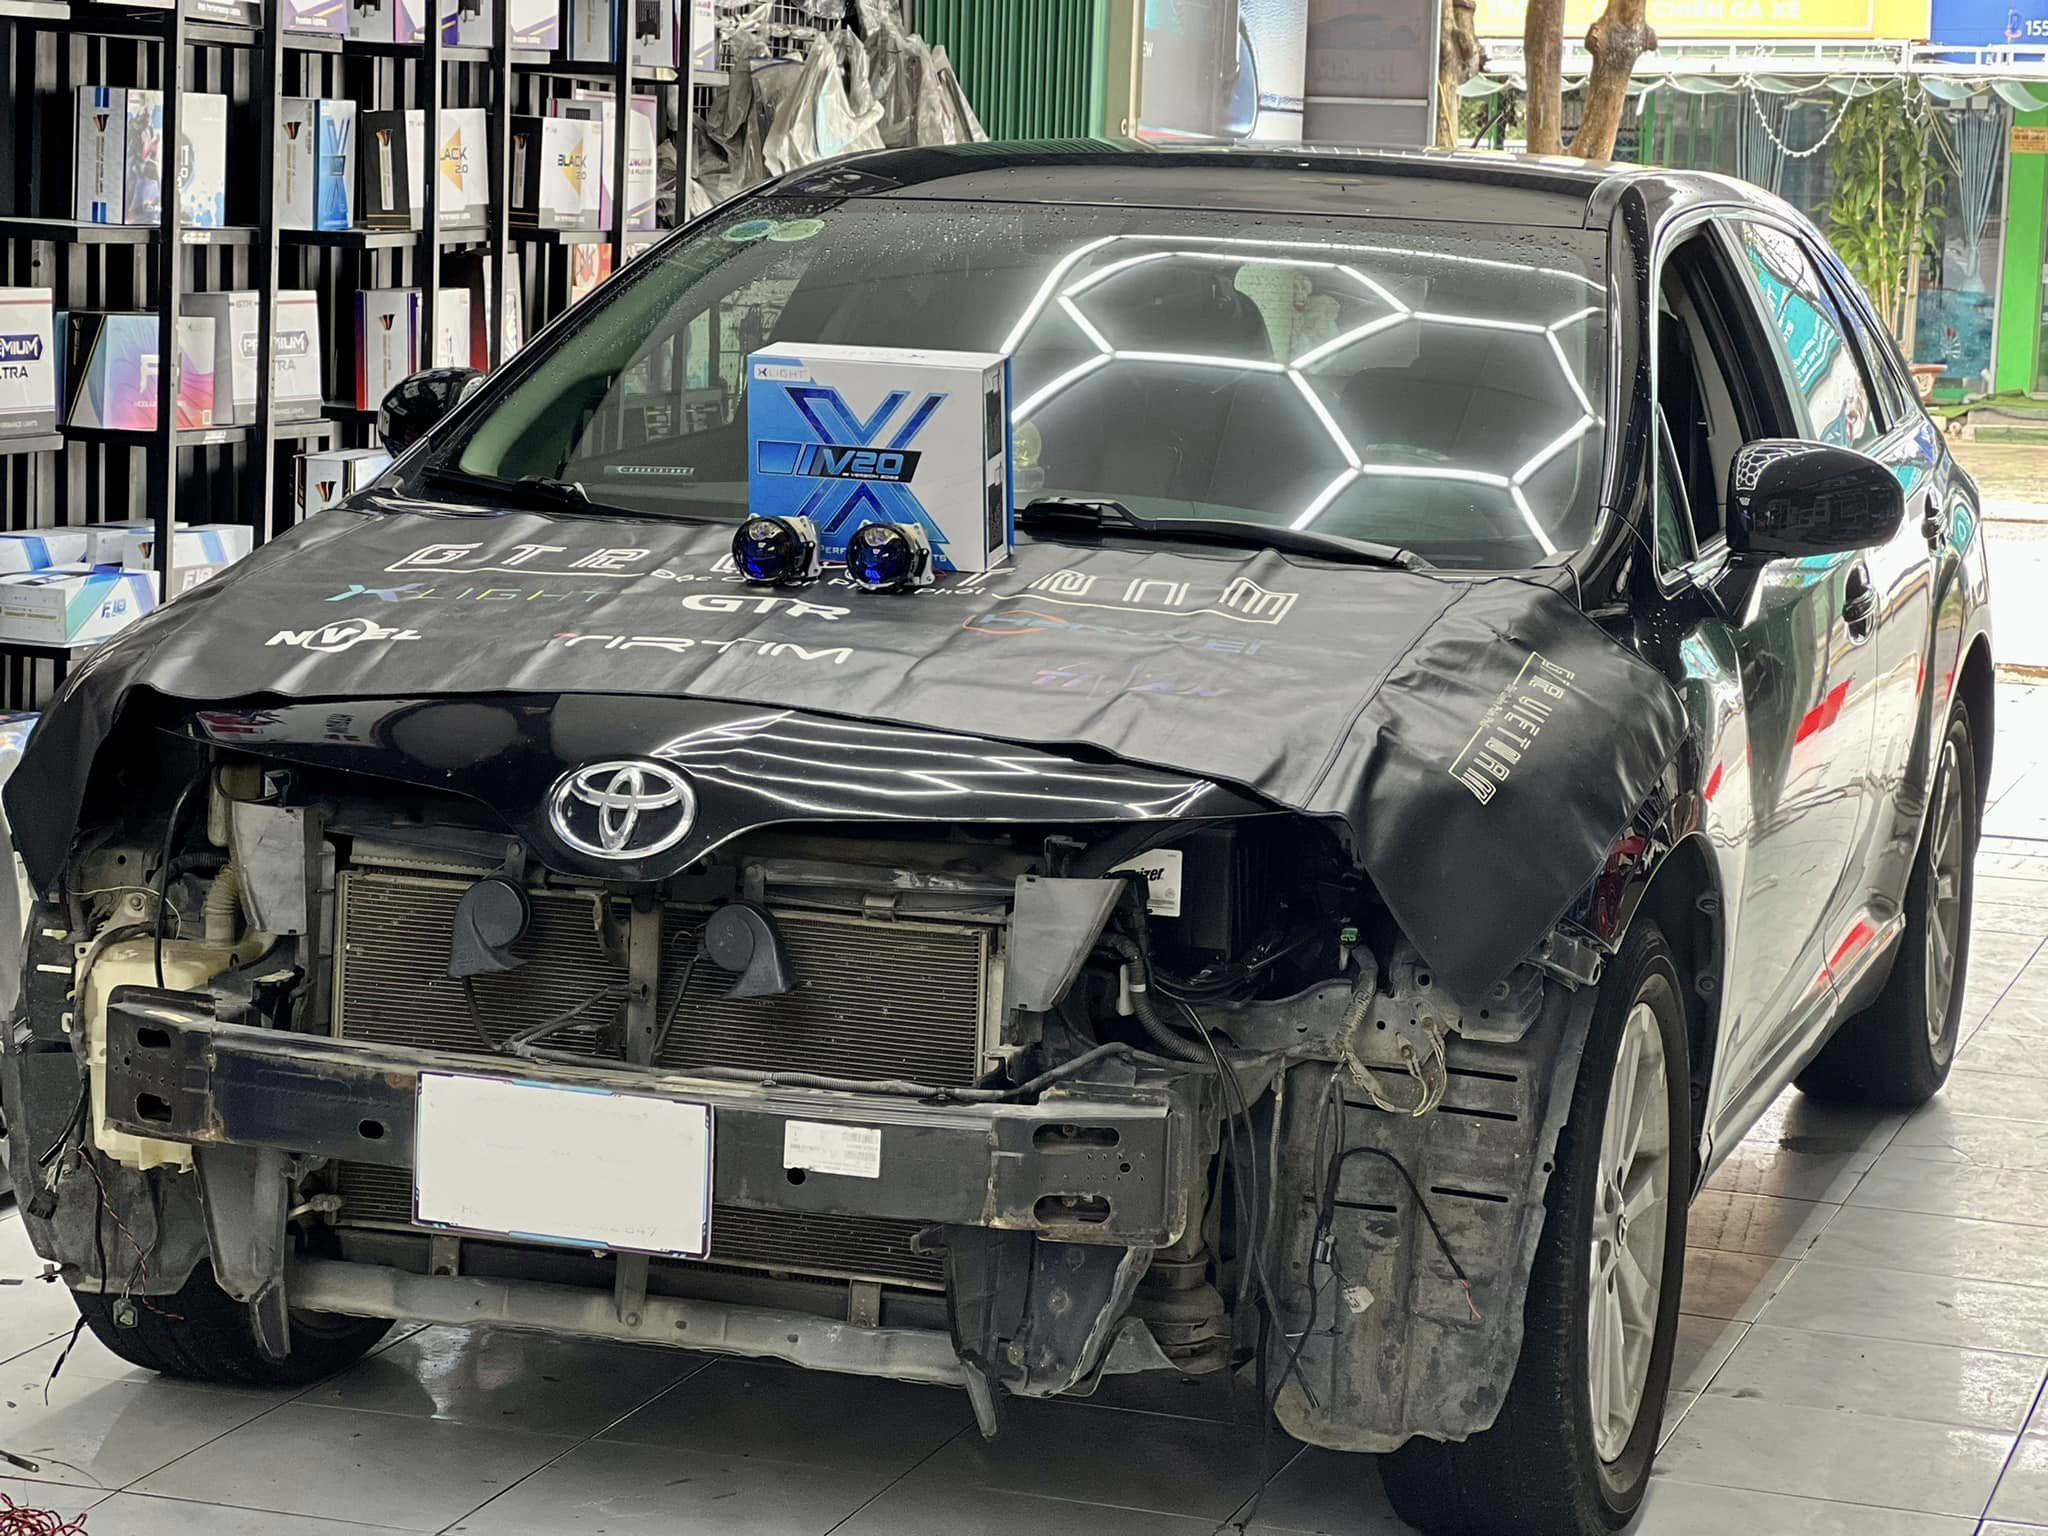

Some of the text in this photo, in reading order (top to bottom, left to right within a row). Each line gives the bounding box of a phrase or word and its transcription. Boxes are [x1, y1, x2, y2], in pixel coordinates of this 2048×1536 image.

[440, 147, 468, 161] LACK
[557, 153, 587, 168] BLACK
[0, 336, 38, 358] MIUM
[0, 366, 28, 379] TRA
[820, 446, 905, 476] V20
[683, 594, 852, 620] GTR
